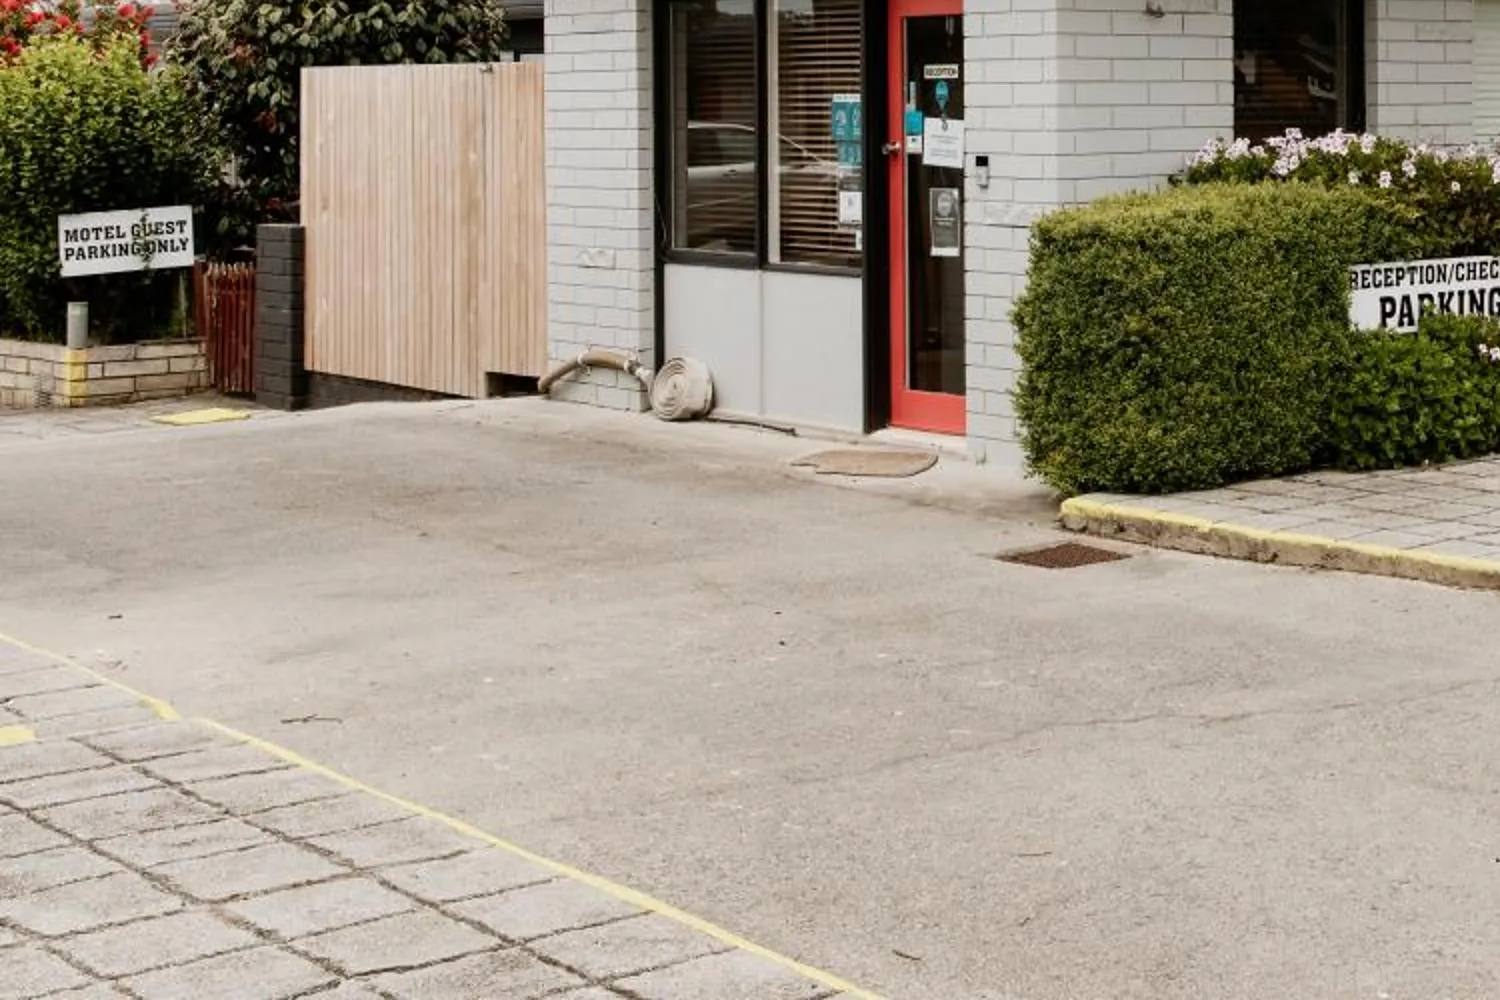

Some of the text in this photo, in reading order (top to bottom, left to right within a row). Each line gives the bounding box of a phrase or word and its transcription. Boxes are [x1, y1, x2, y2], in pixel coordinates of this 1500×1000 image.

[64, 219, 188, 243] MOTEL GUEST
[64, 237, 190, 261] PARKING ONLY
